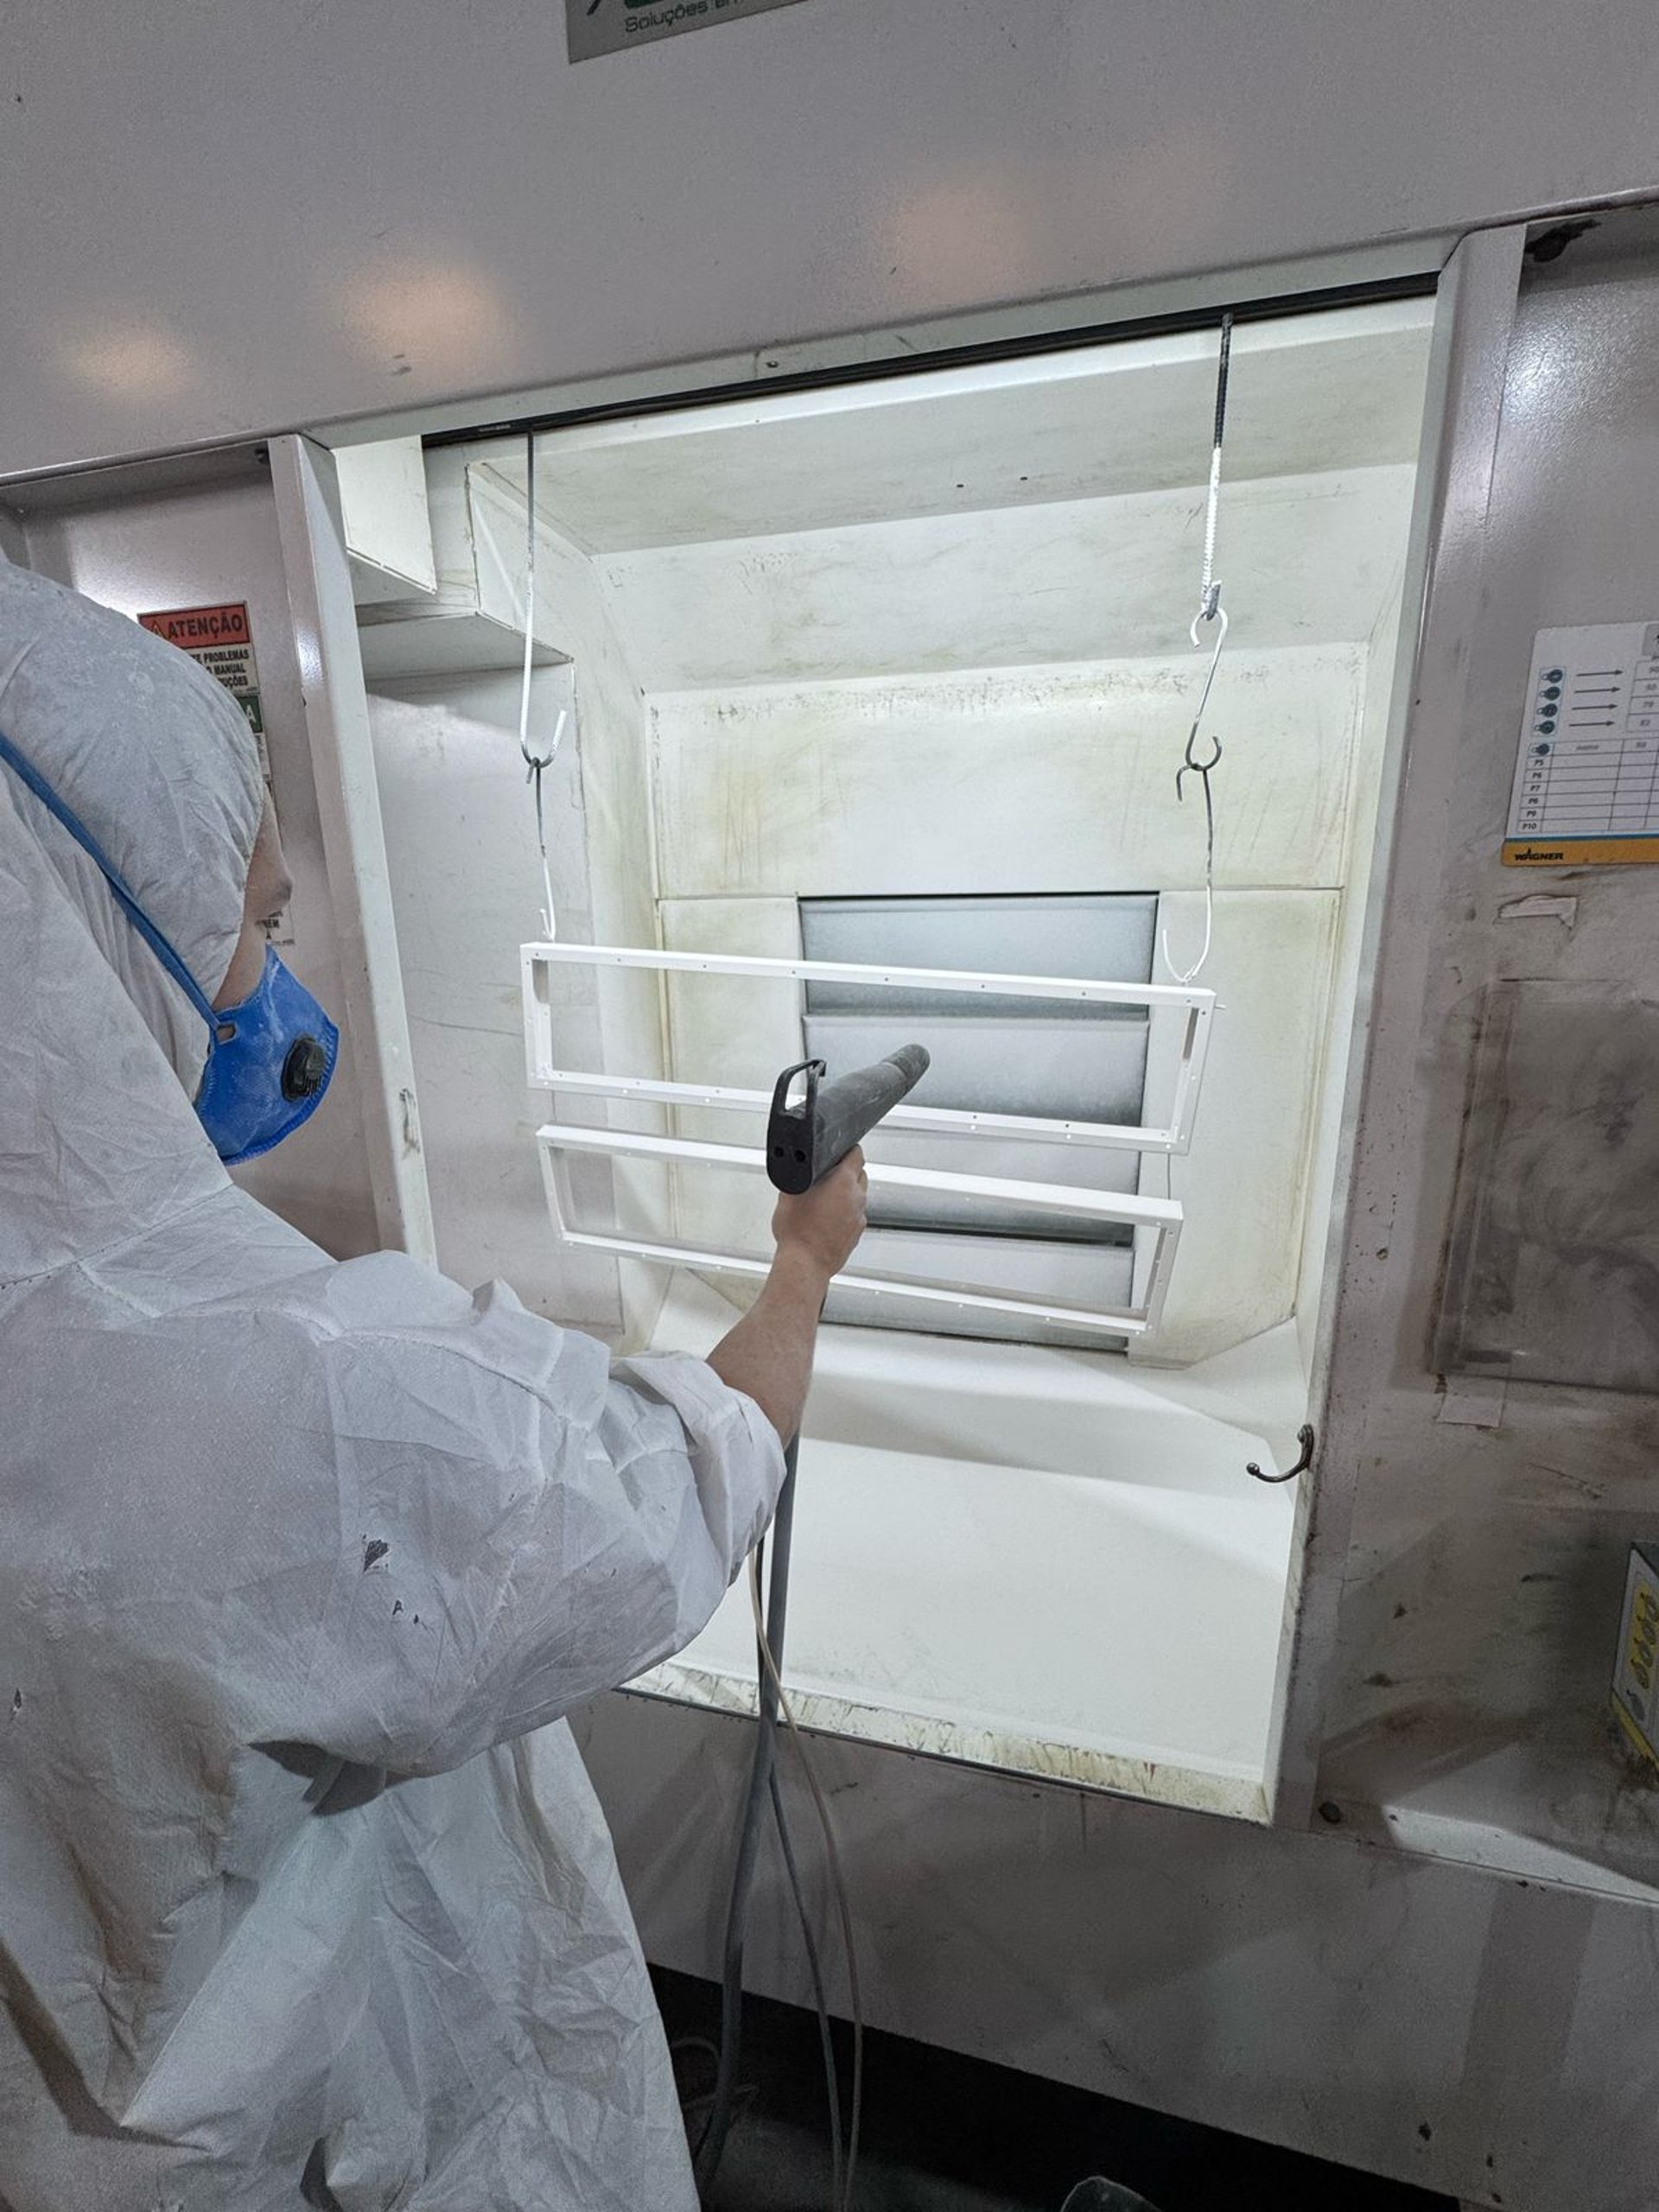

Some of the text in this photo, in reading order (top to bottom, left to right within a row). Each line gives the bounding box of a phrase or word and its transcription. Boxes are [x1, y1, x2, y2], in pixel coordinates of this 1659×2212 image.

[624, 1, 709, 33] Soluções
[168, 612, 243, 639] ATENÇÃO
[204, 649, 250, 664] PROBLEMAS
[214, 664, 246, 676] MANUAL
[1515, 848, 1564, 861] WAGNER
